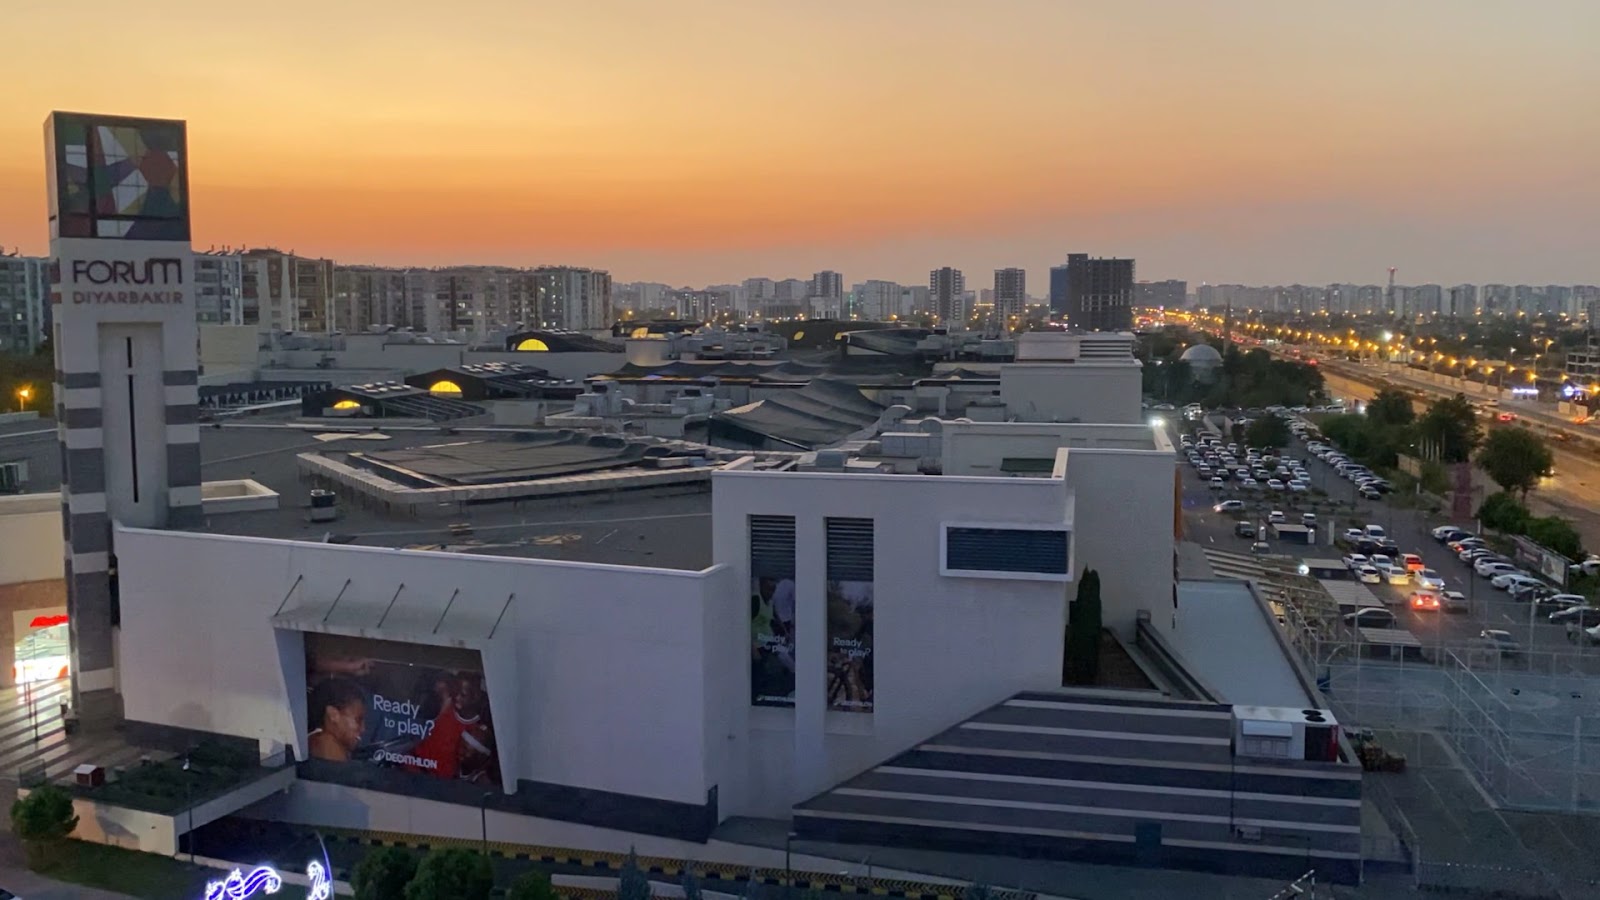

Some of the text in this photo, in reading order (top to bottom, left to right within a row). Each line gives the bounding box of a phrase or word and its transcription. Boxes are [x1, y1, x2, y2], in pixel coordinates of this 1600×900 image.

[72, 258, 182, 284] FORUM
[833, 637, 862, 648] Ready
[848, 648, 871, 660] play?
[373, 694, 420, 719] Ready
[384, 717, 435, 740] to play?
